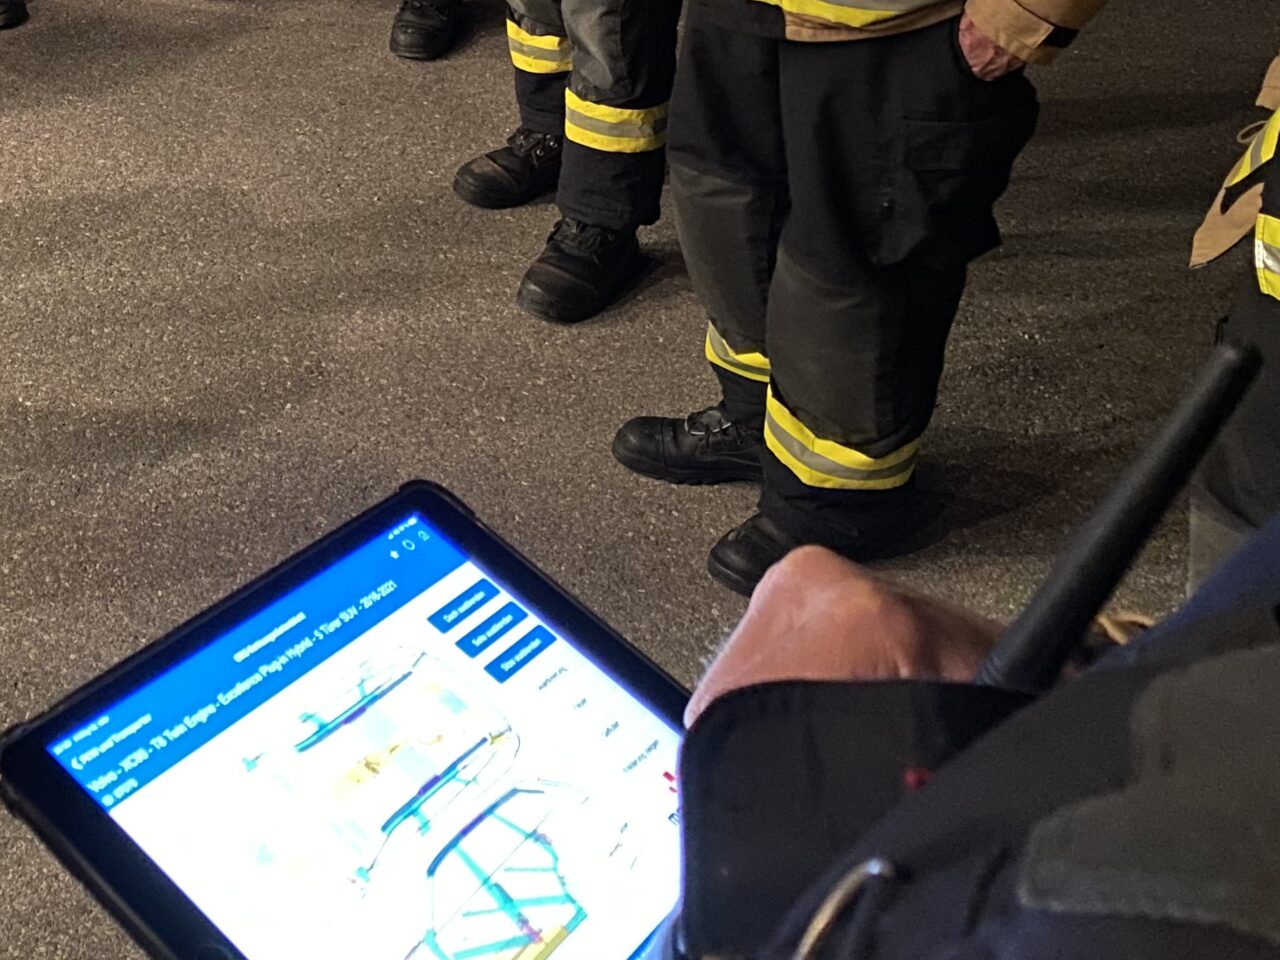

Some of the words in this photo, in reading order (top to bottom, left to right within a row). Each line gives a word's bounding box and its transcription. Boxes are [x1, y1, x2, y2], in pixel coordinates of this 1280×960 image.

[86, 770, 117, 792] Volvo
[162, 723, 187, 740] Twin
[182, 703, 216, 728] Engine
[285, 637, 313, 658] Hybrid
[338, 605, 358, 622] SUV
